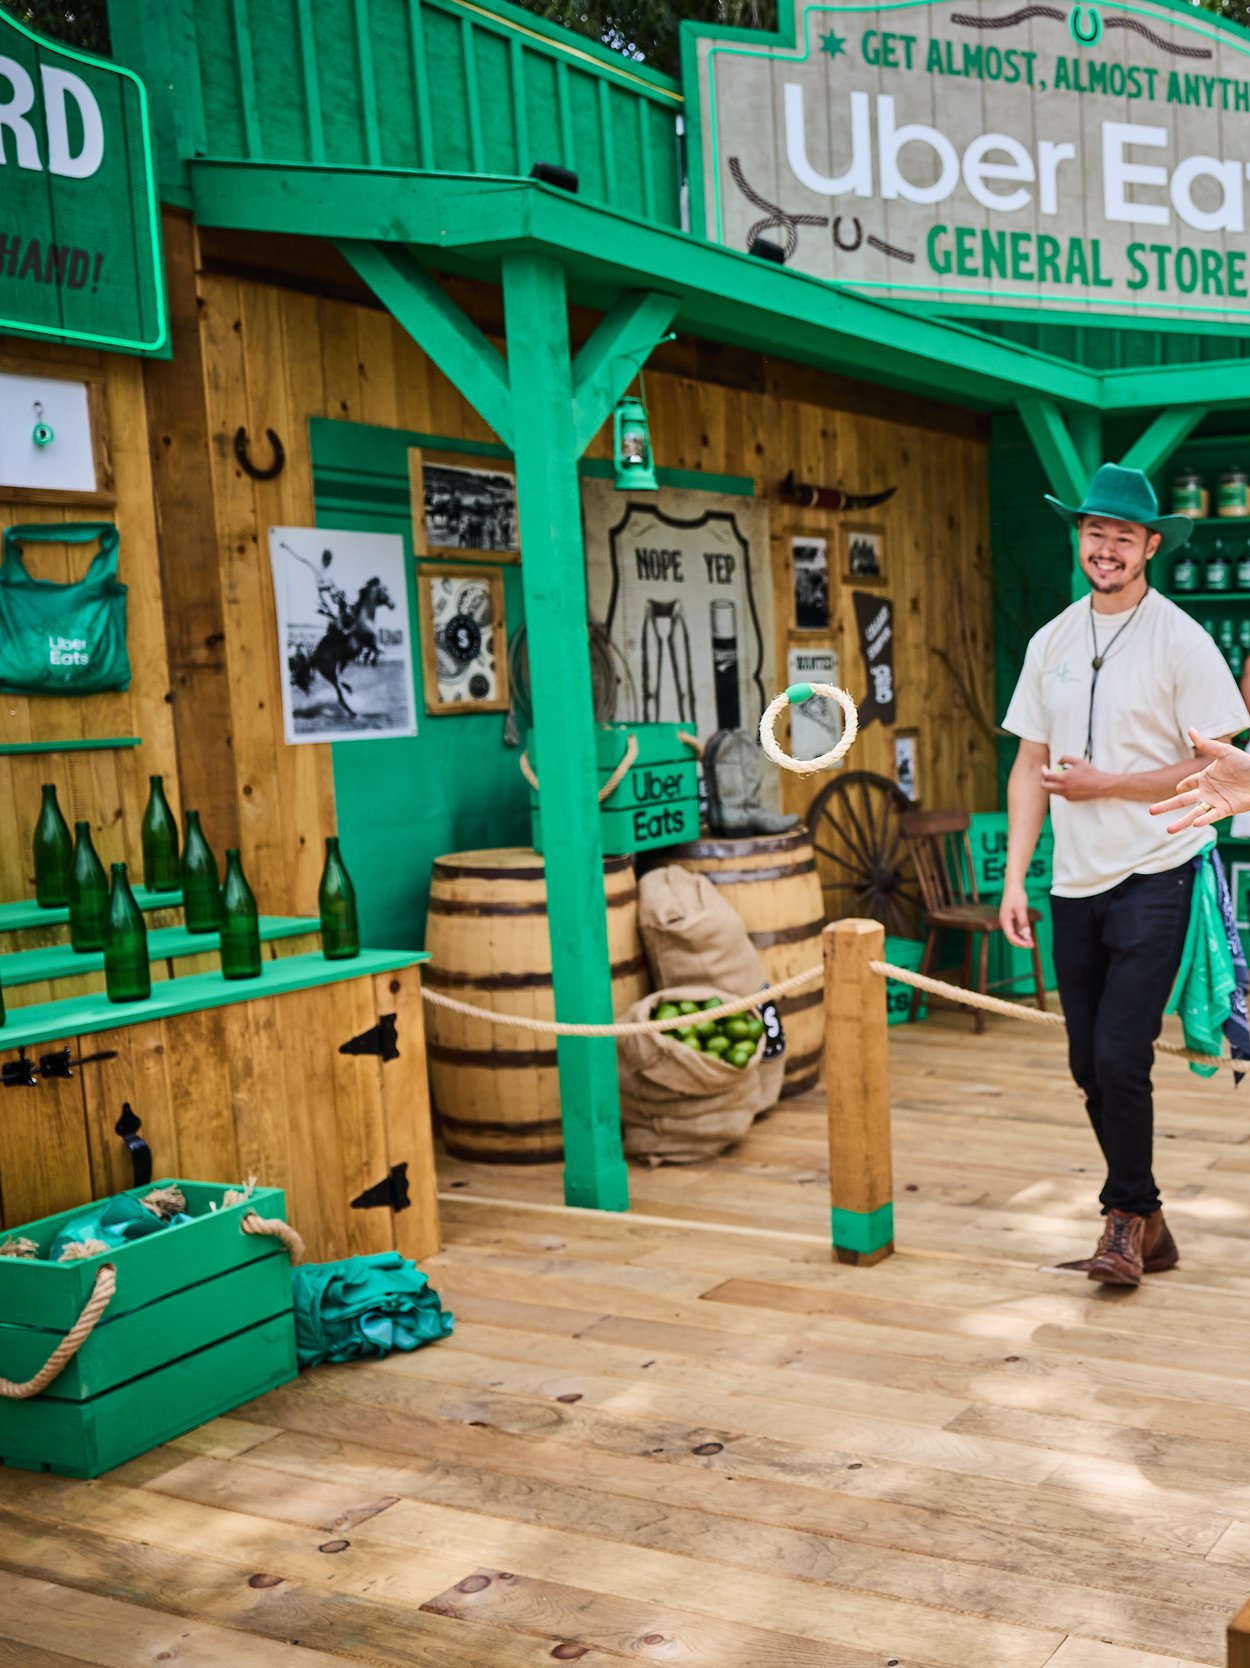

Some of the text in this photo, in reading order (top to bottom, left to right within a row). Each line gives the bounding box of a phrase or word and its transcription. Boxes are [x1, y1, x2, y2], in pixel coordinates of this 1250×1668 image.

[860, 29, 917, 71] GET
[925, 42, 1048, 93] ALMOST,
[1054, 55, 1159, 101] ALMOST
[783, 83, 1076, 216] Uber
[926, 224, 1249, 298] GENERAL STORE
[634, 546, 736, 585] NOPE YEP
[48, 635, 87, 651] Uber
[50, 648, 89, 666] Eats
[632, 771, 684, 802] Uber
[633, 808, 686, 842] Eats
